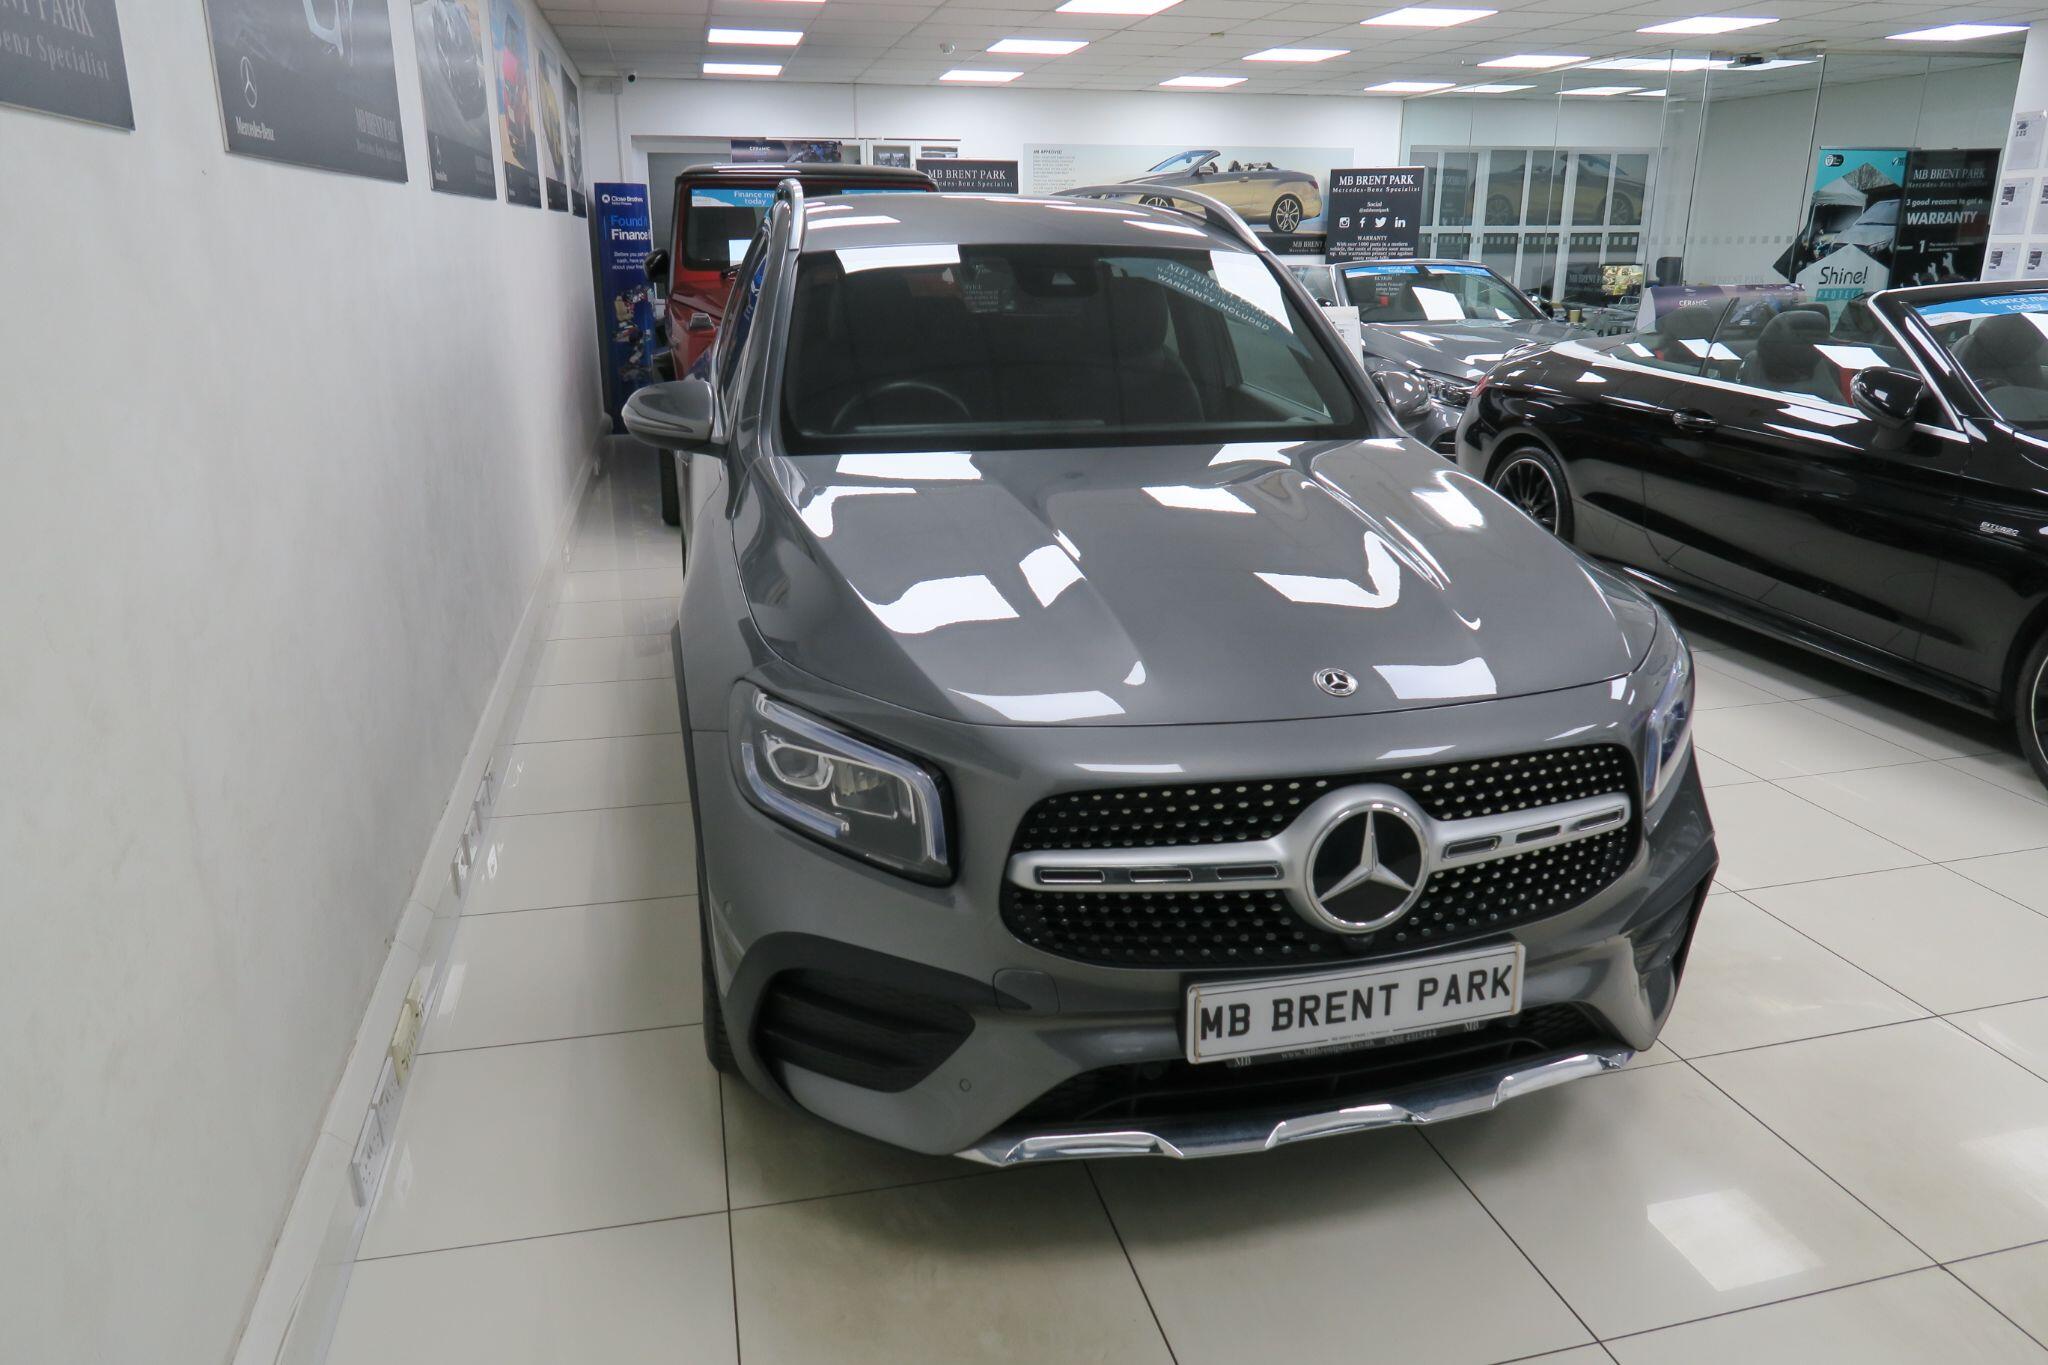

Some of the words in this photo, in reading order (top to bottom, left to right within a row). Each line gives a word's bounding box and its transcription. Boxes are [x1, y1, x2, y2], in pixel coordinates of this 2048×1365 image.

[36, 34, 110, 80] Specialist
[928, 169, 943, 179] MB
[946, 169, 977, 179] BRENT
[980, 169, 1006, 179] PARK
[1913, 169, 1928, 180] MB
[1930, 169, 1961, 179] BRENT
[1962, 168, 1985, 179] PARK
[978, 180, 1013, 188] Specialist
[1339, 175, 1353, 185] MB
[1356, 175, 1387, 185] BRENT
[1389, 175, 1414, 185] PARK
[744, 197, 767, 206] today
[1912, 198, 1930, 207] good
[611, 215, 643, 228] Found
[1906, 211, 1978, 225] WARRANTY
[611, 229, 648, 240] Finance
[1818, 266, 1868, 285] Shine!
[1157, 274, 1216, 302] WARRANTY
[1217, 302, 1270, 330] INCLUDED
[1678, 299, 1708, 308] CERAMIC
[1980, 296, 2028, 306] Finance
[2006, 302, 2043, 311] today
[1200, 1002, 1250, 1040] MB
[1271, 983, 1399, 1032] BRENT
[1417, 964, 1513, 1011] PARK
